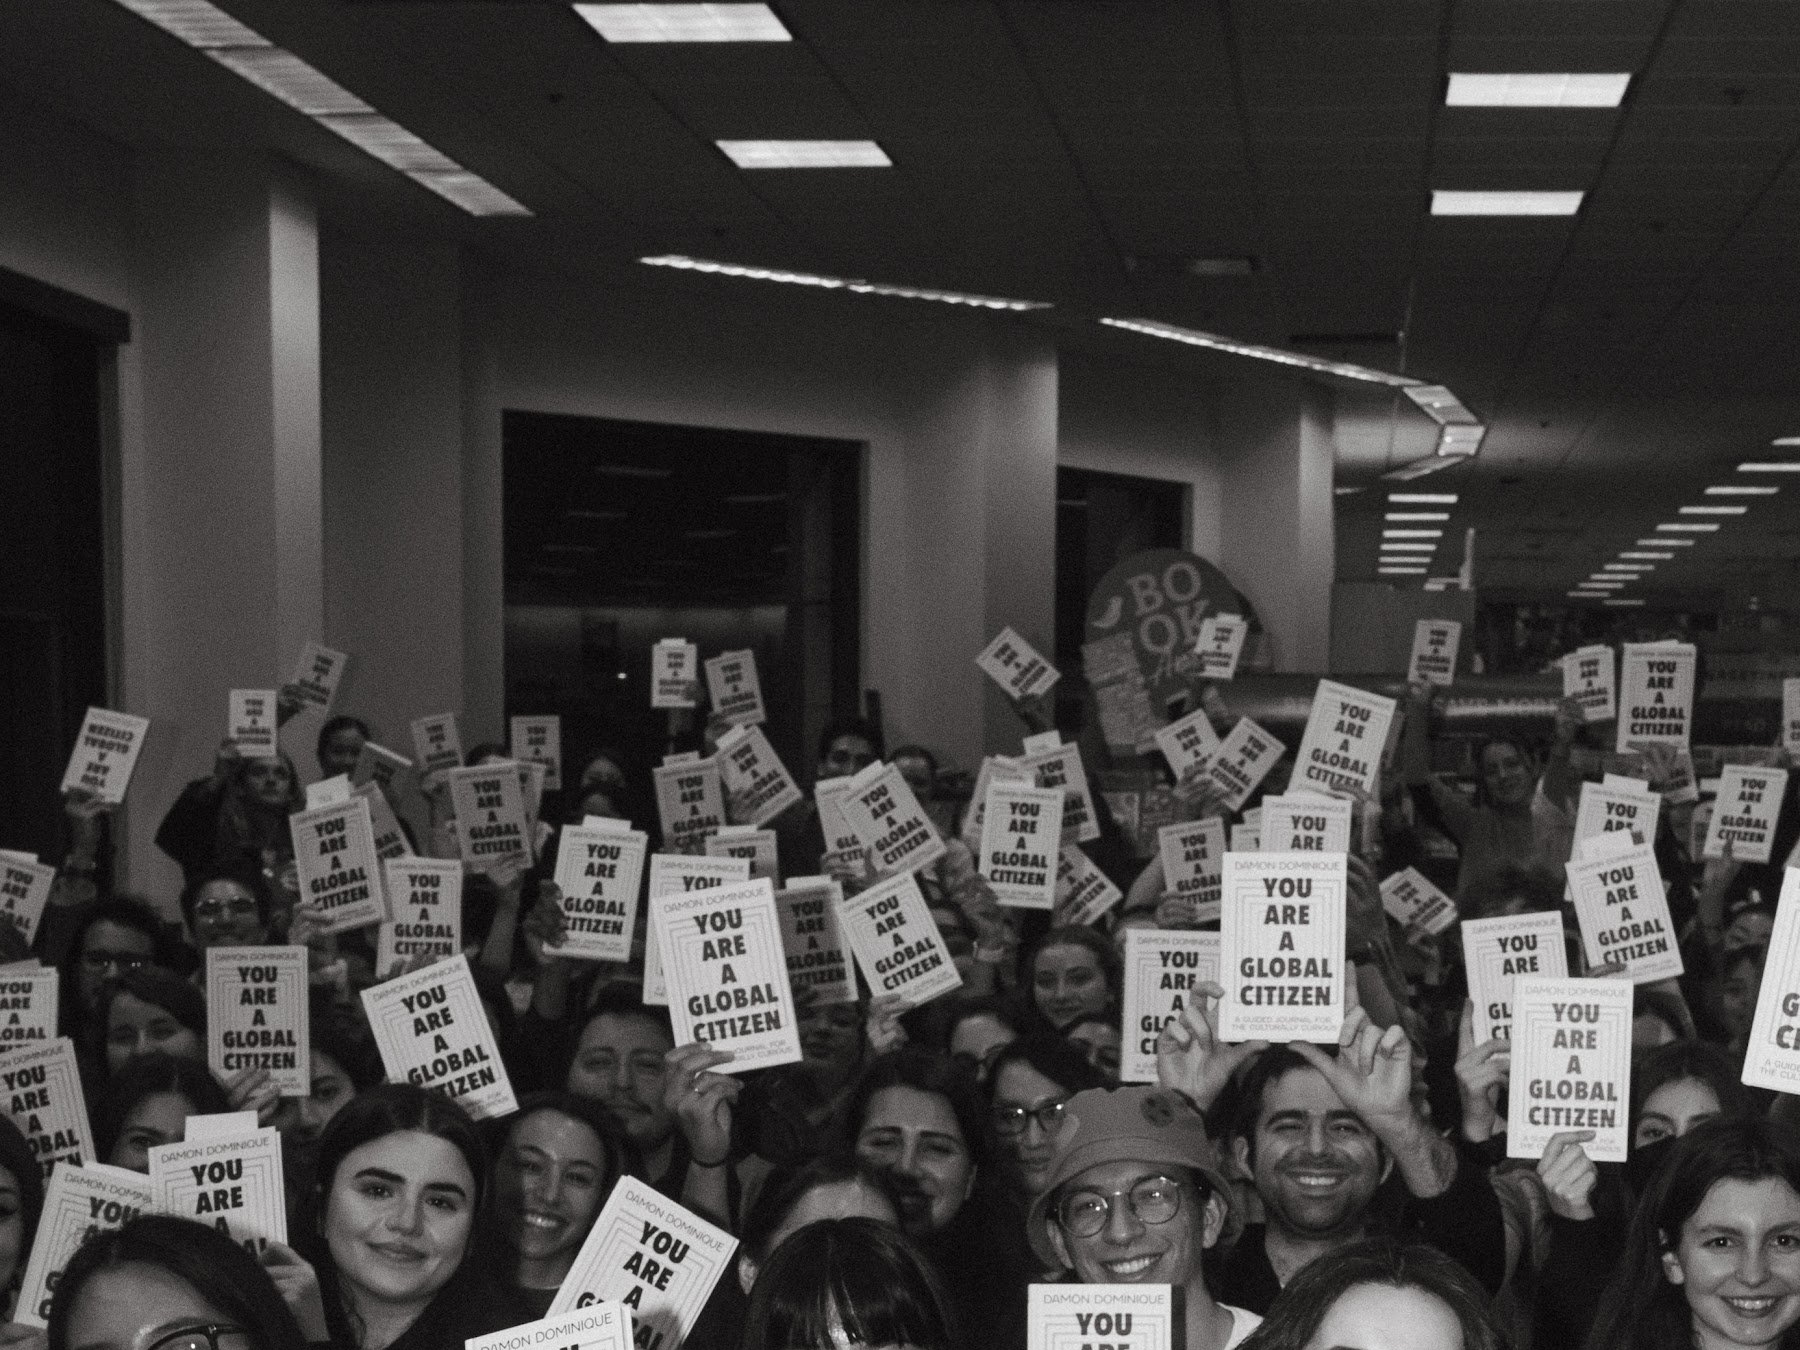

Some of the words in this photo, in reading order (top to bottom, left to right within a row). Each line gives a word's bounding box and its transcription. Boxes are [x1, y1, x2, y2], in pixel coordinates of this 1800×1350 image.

[1647, 661, 1677, 674] YOU
[1647, 676, 1674, 689] ARE
[1655, 692, 1664, 703] A
[1339, 701, 1372, 722] YOU
[1631, 707, 1685, 720] GLOBAL
[1335, 719, 1365, 738] ARE
[1631, 723, 1683, 736] CITIZEN
[1339, 738, 1350, 752] A
[1038, 759, 1065, 775] YOU
[1310, 748, 1368, 777] GLOBAL
[473, 780, 502, 794] YOU
[677, 775, 704, 790] YOU
[1741, 778, 1767, 790] YOU
[477, 795, 503, 808] ARE
[681, 789, 705, 802] ARE
[860, 784, 889, 807] YOU
[1738, 791, 1761, 803] ARE
[487, 810, 497, 823] A
[690, 804, 699, 816] A
[870, 797, 897, 820] ARE
[1009, 802, 1041, 816] YOU
[1605, 801, 1638, 820] YOU
[315, 817, 345, 838] YOU
[469, 822, 520, 839] GLOBAL
[673, 815, 720, 834] GLOBAL
[887, 815, 897, 828] A
[1008, 820, 1037, 834] ARE
[1291, 814, 1327, 832] YOU
[1721, 816, 1768, 830] GLOBAL
[875, 816, 924, 853] GLOBAL
[1016, 836, 1026, 850] A
[1180, 832, 1207, 848] YOU
[1291, 837, 1323, 851] ARE
[320, 834, 347, 856] ARE
[472, 839, 522, 855] CITIZEN
[587, 844, 621, 861] YOU
[727, 846, 757, 859] YOU
[883, 829, 931, 866] CITIZEN
[1184, 846, 1208, 861] ARE
[330, 855, 342, 870] A
[585, 861, 617, 879] ARE
[991, 852, 1048, 869] GLOBAL
[1194, 863, 1203, 874] A
[1235, 861, 1276, 872] DAMON
[1279, 861, 1340, 872] DOMINIQUE
[310, 867, 367, 895] GLOBAL
[408, 874, 441, 888] YOU
[682, 876, 722, 892] YOU
[990, 869, 1046, 886] CITIZEN
[1598, 866, 1635, 887] YOU
[592, 881, 604, 896] A
[1263, 878, 1312, 898] YOU
[1605, 885, 1639, 907] ARE
[409, 891, 439, 905] ARE
[563, 898, 626, 916] GLOBAL
[663, 899, 704, 913] DAMON
[706, 886, 765, 906] DOMINIQUE
[865, 895, 900, 920] YOU
[419, 908, 429, 921] A
[693, 908, 743, 935] YOU
[1264, 905, 1310, 925] ARE
[1620, 906, 1633, 921] A
[394, 924, 454, 938] GLOBAL
[875, 911, 907, 937] ARE
[1597, 918, 1666, 948] GLOBAL
[702, 935, 747, 962] ARE
[892, 933, 905, 947] A
[1279, 931, 1294, 951] A
[1498, 934, 1538, 954] YOU
[874, 936, 936, 975] GLOBAL
[1160, 951, 1199, 969] YOU
[238, 966, 277, 983] YOU
[721, 963, 737, 985] A
[883, 952, 943, 992] CITIZEN
[1240, 958, 1333, 978] GLOBAL
[1503, 956, 1539, 976] ARE
[372, 981, 411, 1003] DAMON
[410, 962, 463, 988] DOMINIQUE
[1524, 986, 1565, 997] DAMON
[1568, 986, 1628, 998] DOMINIQUE
[239, 987, 277, 1006] ARE
[402, 985, 448, 1015] YOU
[687, 983, 779, 1018] GLOBAL
[1171, 994, 1184, 1011] A
[1240, 985, 1331, 1006] CITIZEN
[252, 1009, 265, 1027] A
[413, 1007, 455, 1039] ARE
[1552, 1003, 1600, 1024] YOU
[693, 1009, 782, 1044] CITIZEN
[222, 1029, 296, 1049] GLOBAL
[432, 1032, 450, 1053] A
[1553, 1029, 1597, 1049] ARE
[223, 1053, 296, 1071] CITIZEN
[408, 1042, 491, 1087] GLOBAL
[1566, 1055, 1582, 1075] A
[2, 1065, 47, 1091] YOU
[1528, 1079, 1618, 1102] GLOBAL
[11, 1091, 50, 1115] ARE
[28, 1113, 43, 1133] A
[1528, 1106, 1616, 1128] CITIZEN
[160, 1144, 203, 1164] DAMON
[205, 1136, 271, 1157] DOMINIQUE
[190, 1158, 243, 1186] YOU
[195, 1186, 244, 1215] ARE
[625, 1190, 665, 1218] DAMON
[665, 1213, 724, 1253] DOMINIQUE
[640, 1220, 690, 1264] YOU
[623, 1251, 674, 1291] ARE
[623, 1285, 644, 1311] A
[1043, 1294, 1090, 1305] DAMON
[1095, 1294, 1165, 1305] DOMINIQUE
[536, 1312, 613, 1344] DOMINIQUE
[1076, 1313, 1132, 1336] YOU
